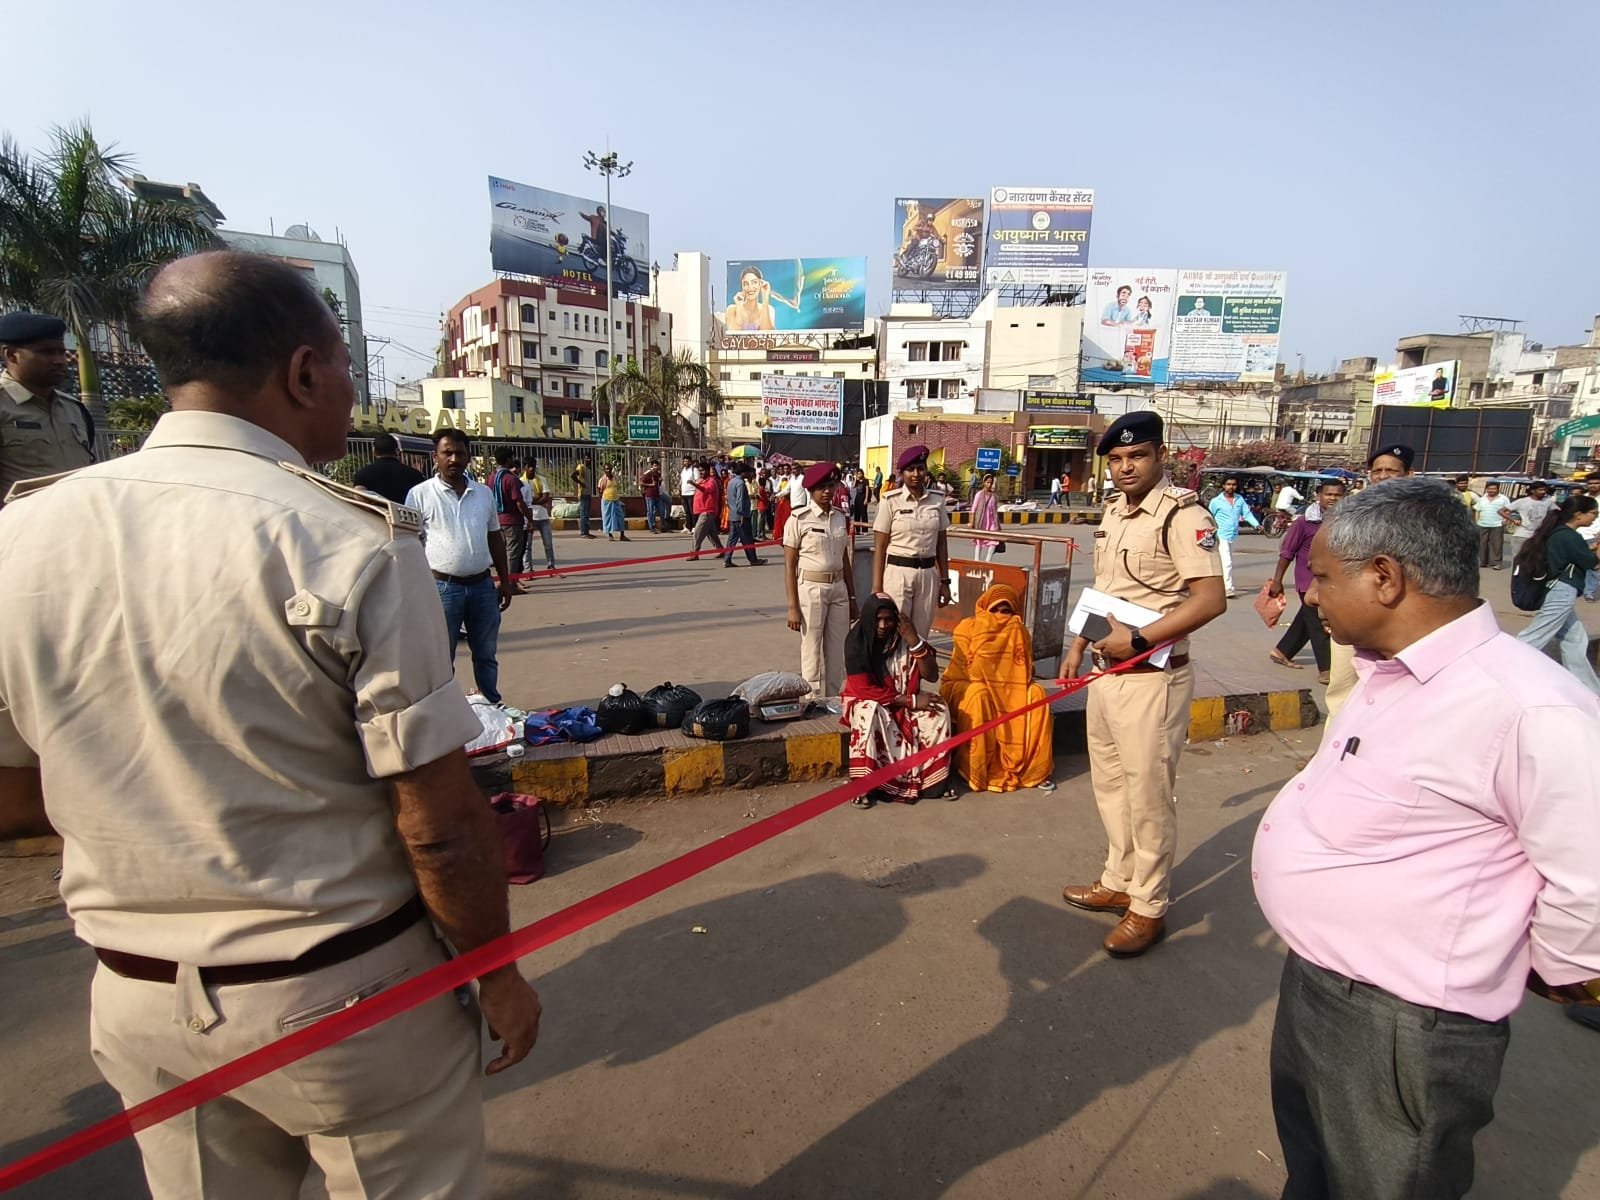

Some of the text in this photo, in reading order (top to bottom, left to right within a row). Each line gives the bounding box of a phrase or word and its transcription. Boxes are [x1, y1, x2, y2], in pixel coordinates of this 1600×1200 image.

[992, 230, 1087, 243] आयुष्मान भारत
[562, 268, 593, 282] HOTEL
[721, 337, 775, 349] GAYLORD
[353, 404, 546, 439] HAGALPUR
[552, 413, 590, 440] JN
